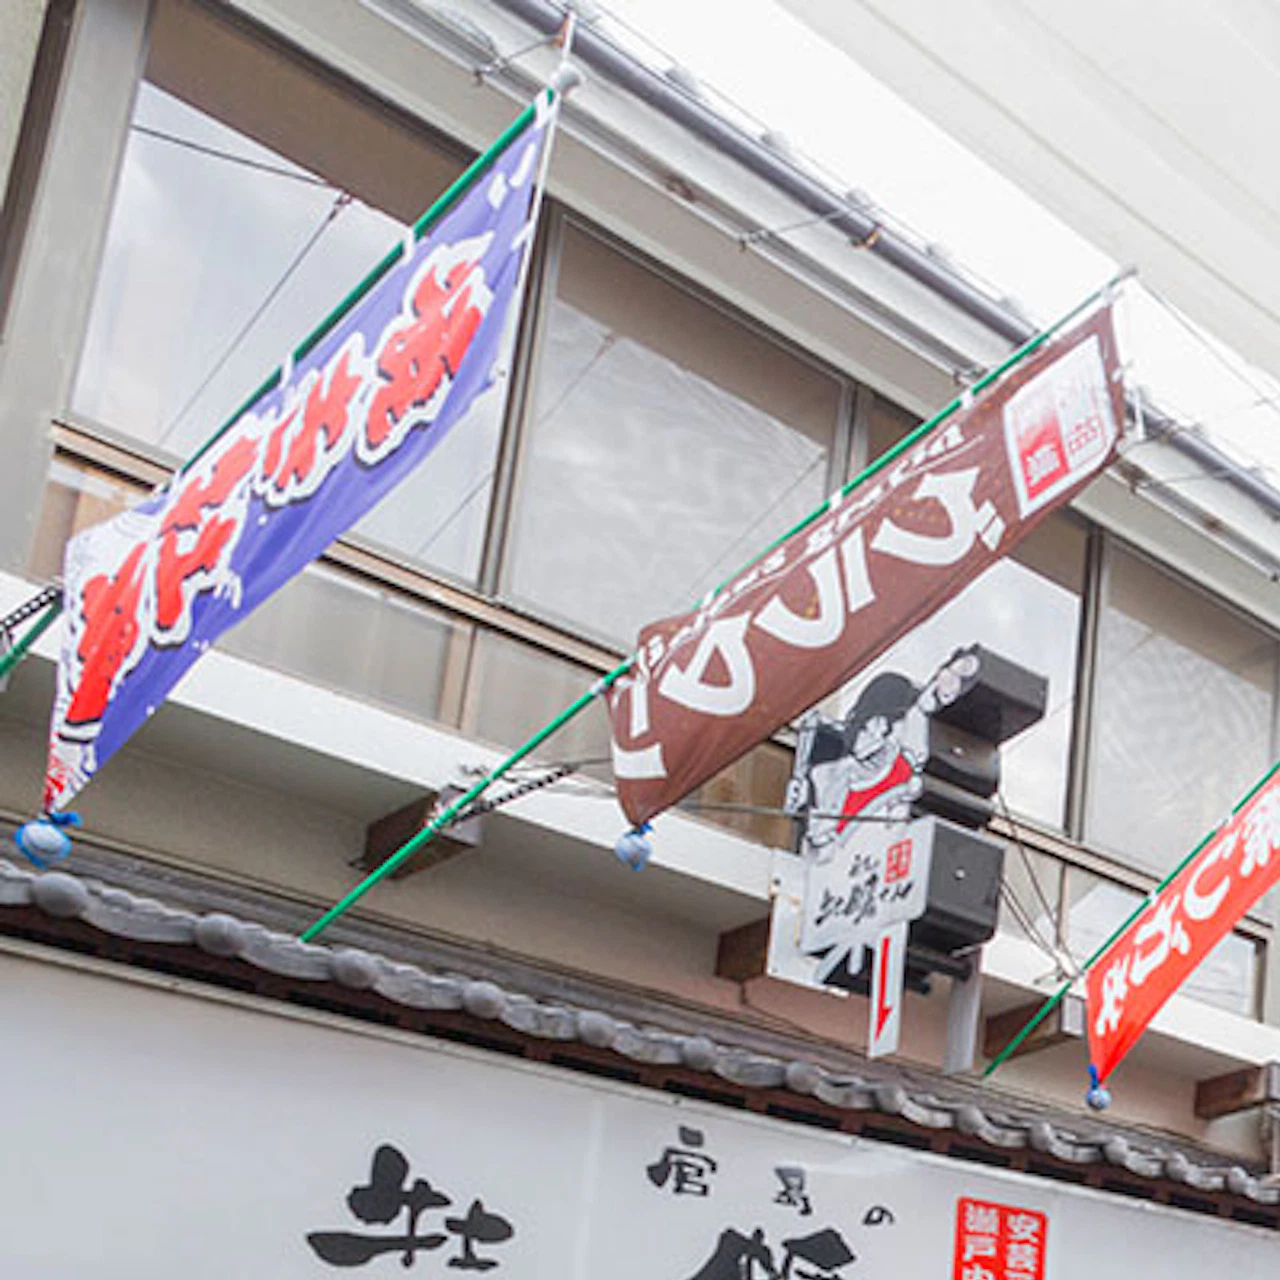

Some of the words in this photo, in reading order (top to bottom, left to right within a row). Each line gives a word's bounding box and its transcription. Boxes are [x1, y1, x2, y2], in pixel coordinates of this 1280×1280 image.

[605, 466, 1005, 782] グラタン
[647, 1125, 896, 1226] 宮島の
